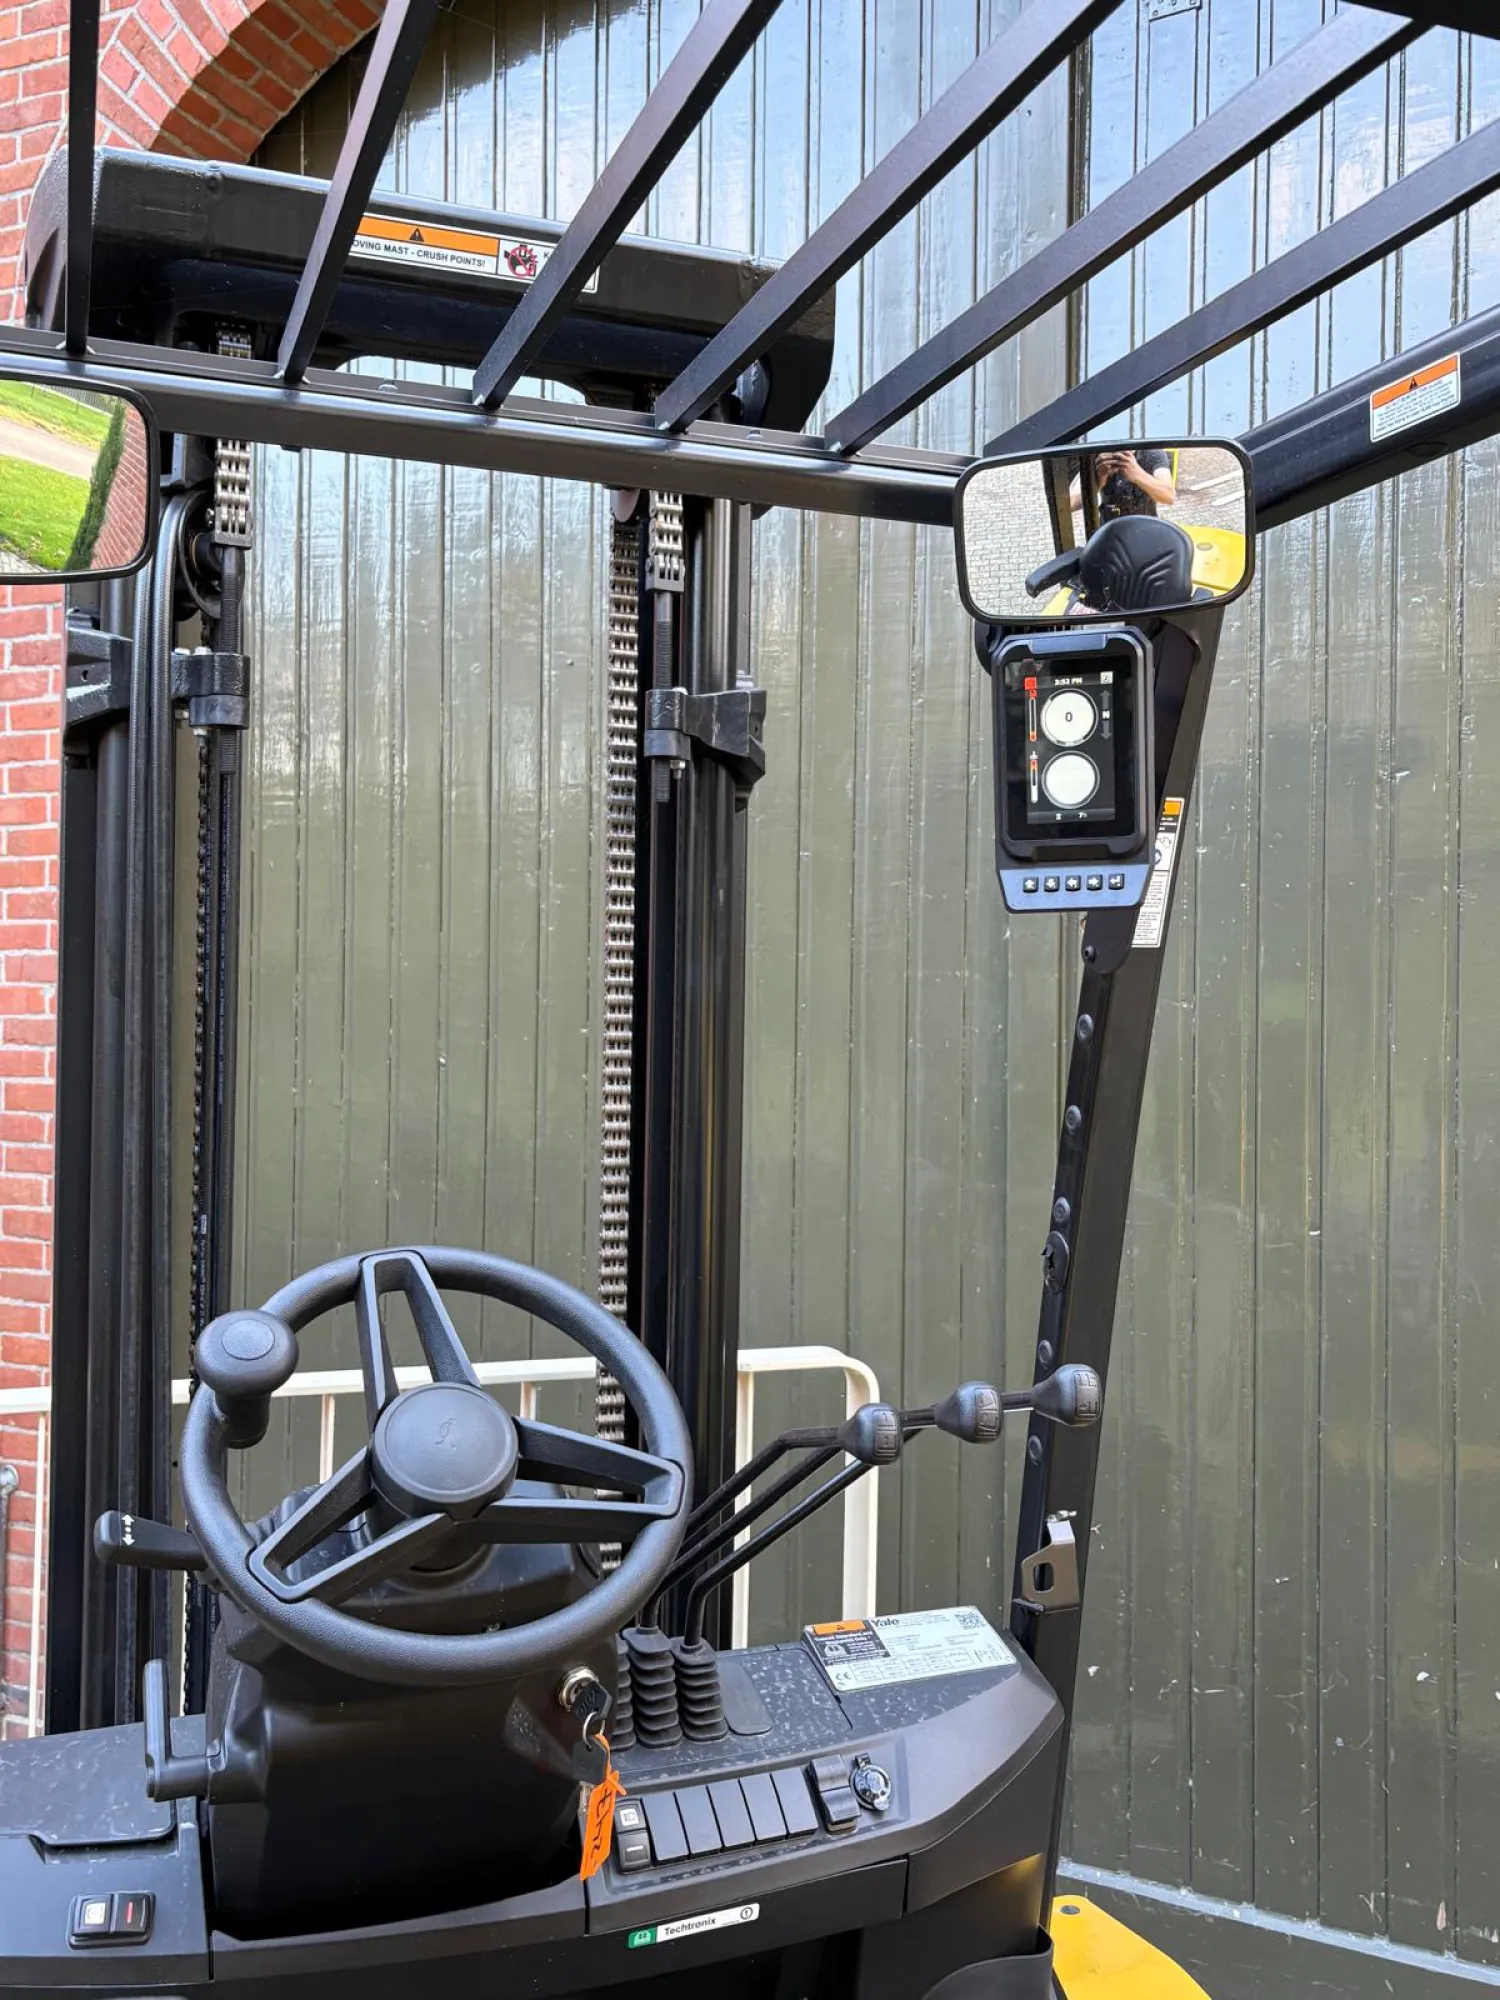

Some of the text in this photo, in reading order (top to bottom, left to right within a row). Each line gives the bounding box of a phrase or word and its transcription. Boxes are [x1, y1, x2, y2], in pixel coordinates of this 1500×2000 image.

[352, 239, 381, 251] OVING
[384, 244, 410, 256] MAST
[416, 249, 448, 262] CRUSH
[450, 254, 486, 268] POINTS!
[1064, 711, 1073, 722] 0
[1102, 710, 1110, 719] N
[871, 1618, 900, 1627] Yale
[664, 1917, 717, 1936] Techtronix
